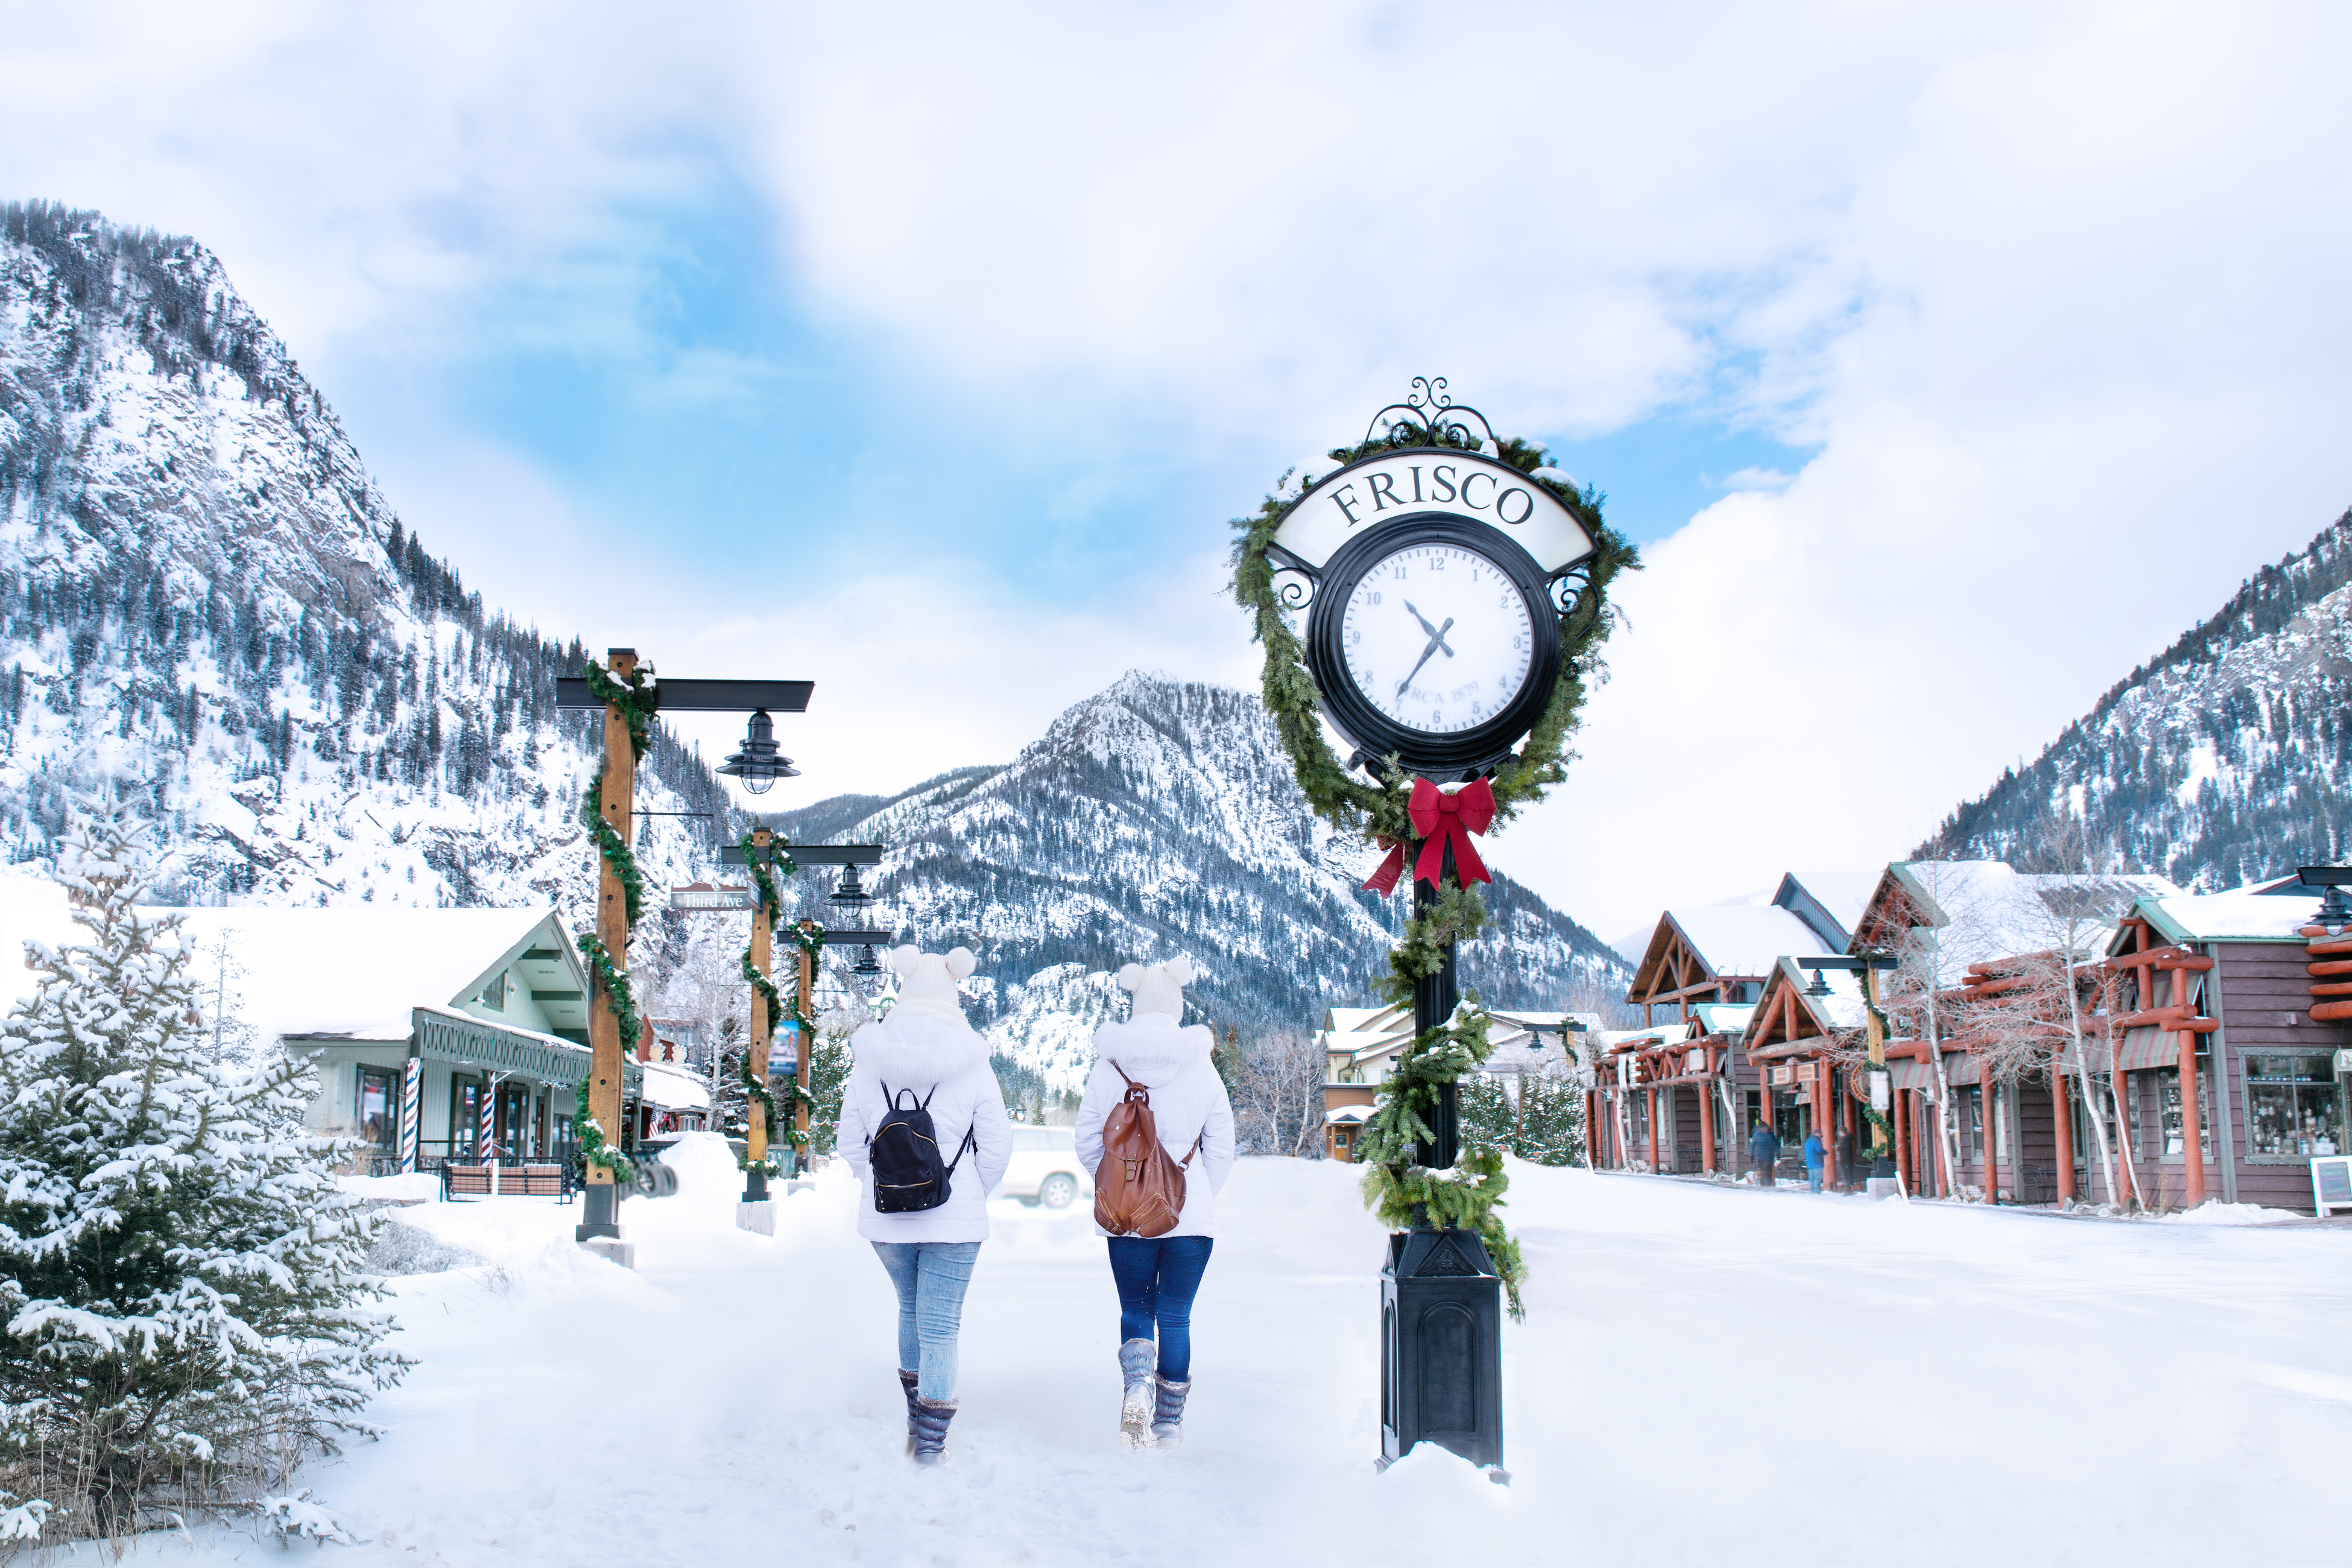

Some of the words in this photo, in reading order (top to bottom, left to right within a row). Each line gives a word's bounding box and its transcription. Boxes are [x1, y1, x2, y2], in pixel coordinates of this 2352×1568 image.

[1327, 466, 1534, 527] FRISCO
[1429, 558, 1445, 570] 12
[1394, 566, 1407, 579] 11
[1473, 569, 1479, 581] 1
[1367, 592, 1381, 605] 10
[1500, 596, 1508, 609] 2
[1353, 631, 1360, 643] 9
[1514, 637, 1521, 649] 3
[1366, 671, 1373, 683] 8
[1499, 675, 1506, 688] 4
[1452, 681, 1479, 701] 1879
[1395, 699, 1402, 712] 7
[1473, 701, 1480, 714] 5
[1432, 710, 1441, 723] 6
[684, 894, 718, 908] Third
[721, 895, 743, 908] Ave
